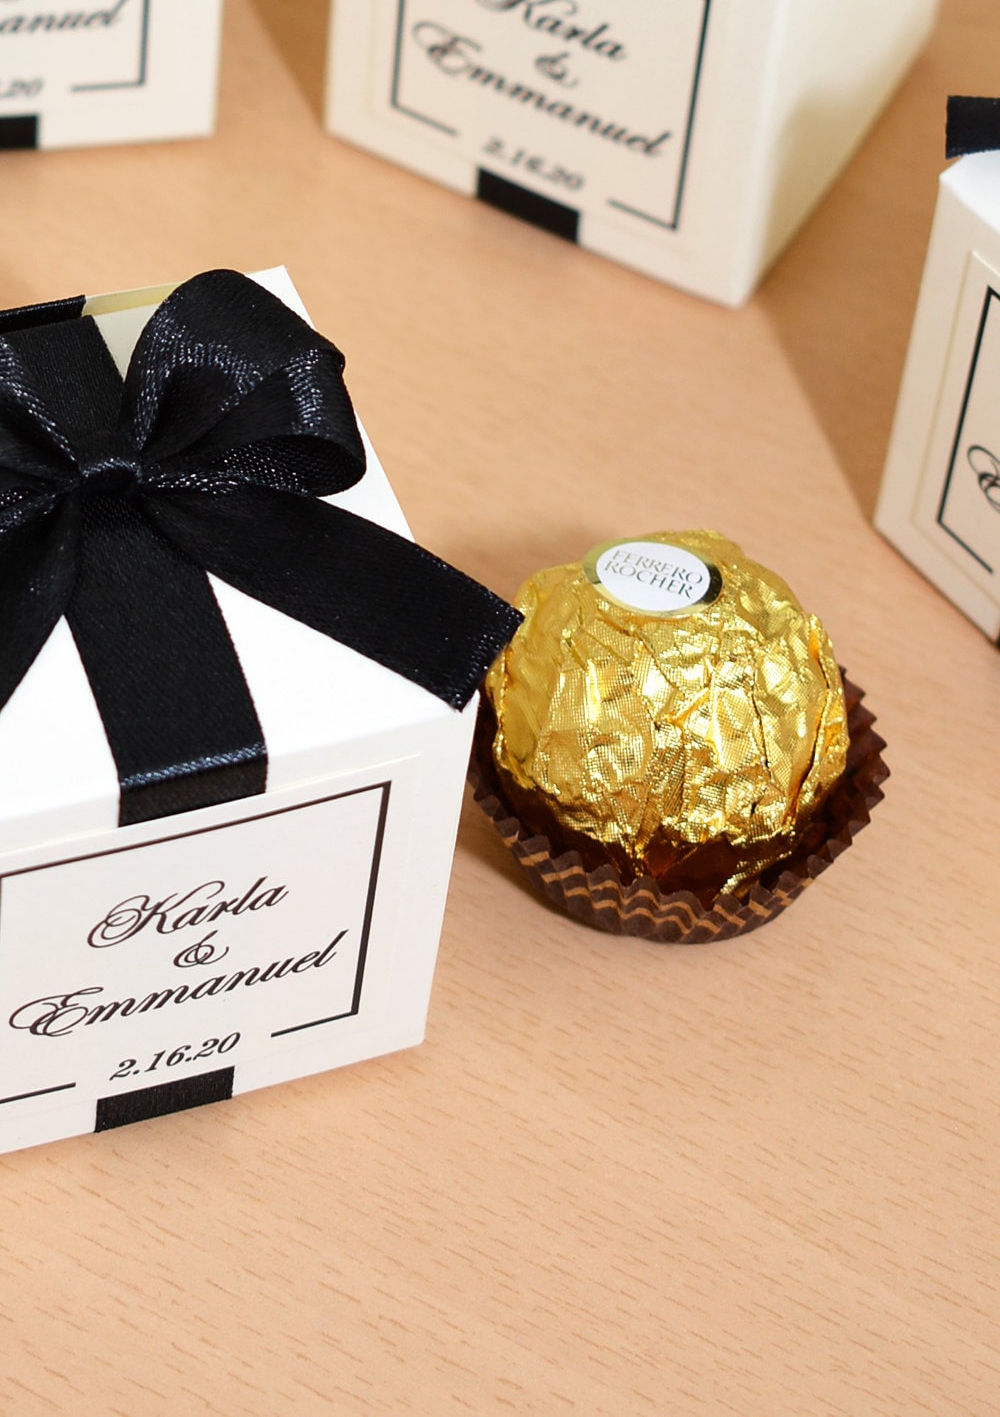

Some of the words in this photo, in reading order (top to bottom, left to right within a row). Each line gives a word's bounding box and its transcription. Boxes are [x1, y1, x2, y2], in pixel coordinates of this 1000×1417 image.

[412, 21, 671, 158] Emmanuel
[535, 51, 579, 88] &
[604, 561, 693, 599] ROCHER
[612, 549, 703, 584] FERRERO
[87, 876, 289, 948] Karla
[173, 930, 229, 968] &
[9, 929, 349, 1037] Emmanuel
[109, 1032, 240, 1081] 2.16.20
